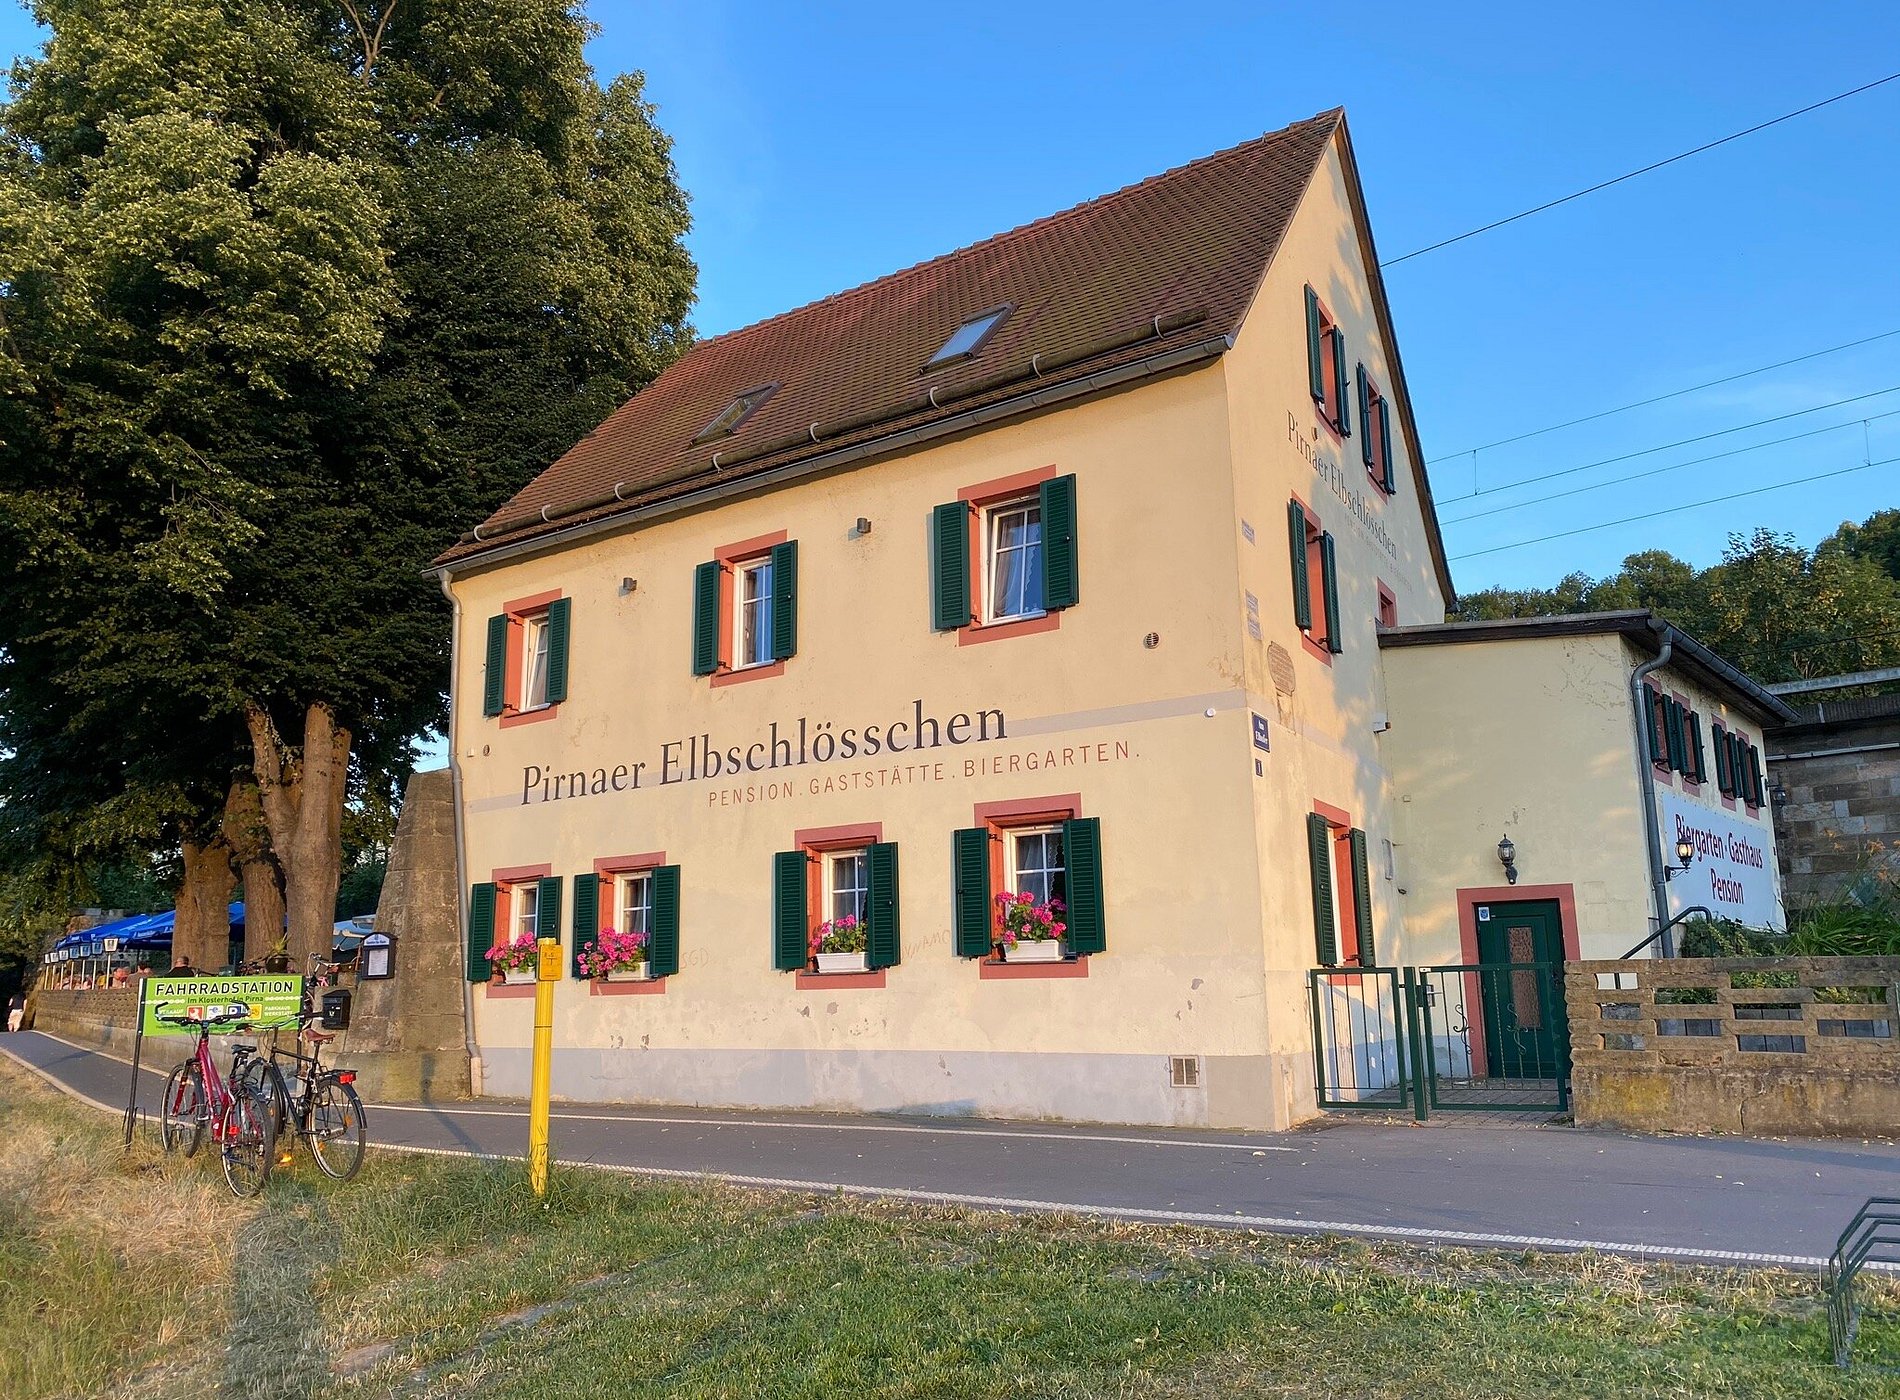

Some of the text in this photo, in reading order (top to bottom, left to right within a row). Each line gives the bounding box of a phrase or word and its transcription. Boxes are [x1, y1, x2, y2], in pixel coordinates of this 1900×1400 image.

[1287, 410, 1328, 482] Pirnaer
[1330, 463, 1397, 560] Elbschlösschen
[521, 699, 1009, 805] Pirnaer Elbschlösschen
[1675, 814, 1725, 862] Biergarten
[1728, 832, 1763, 869] Gasthaus
[1710, 868, 1744, 905] Pension
[156, 981, 293, 995] FAHRRADSTATION
[198, 996, 236, 1004] Klosterhof
